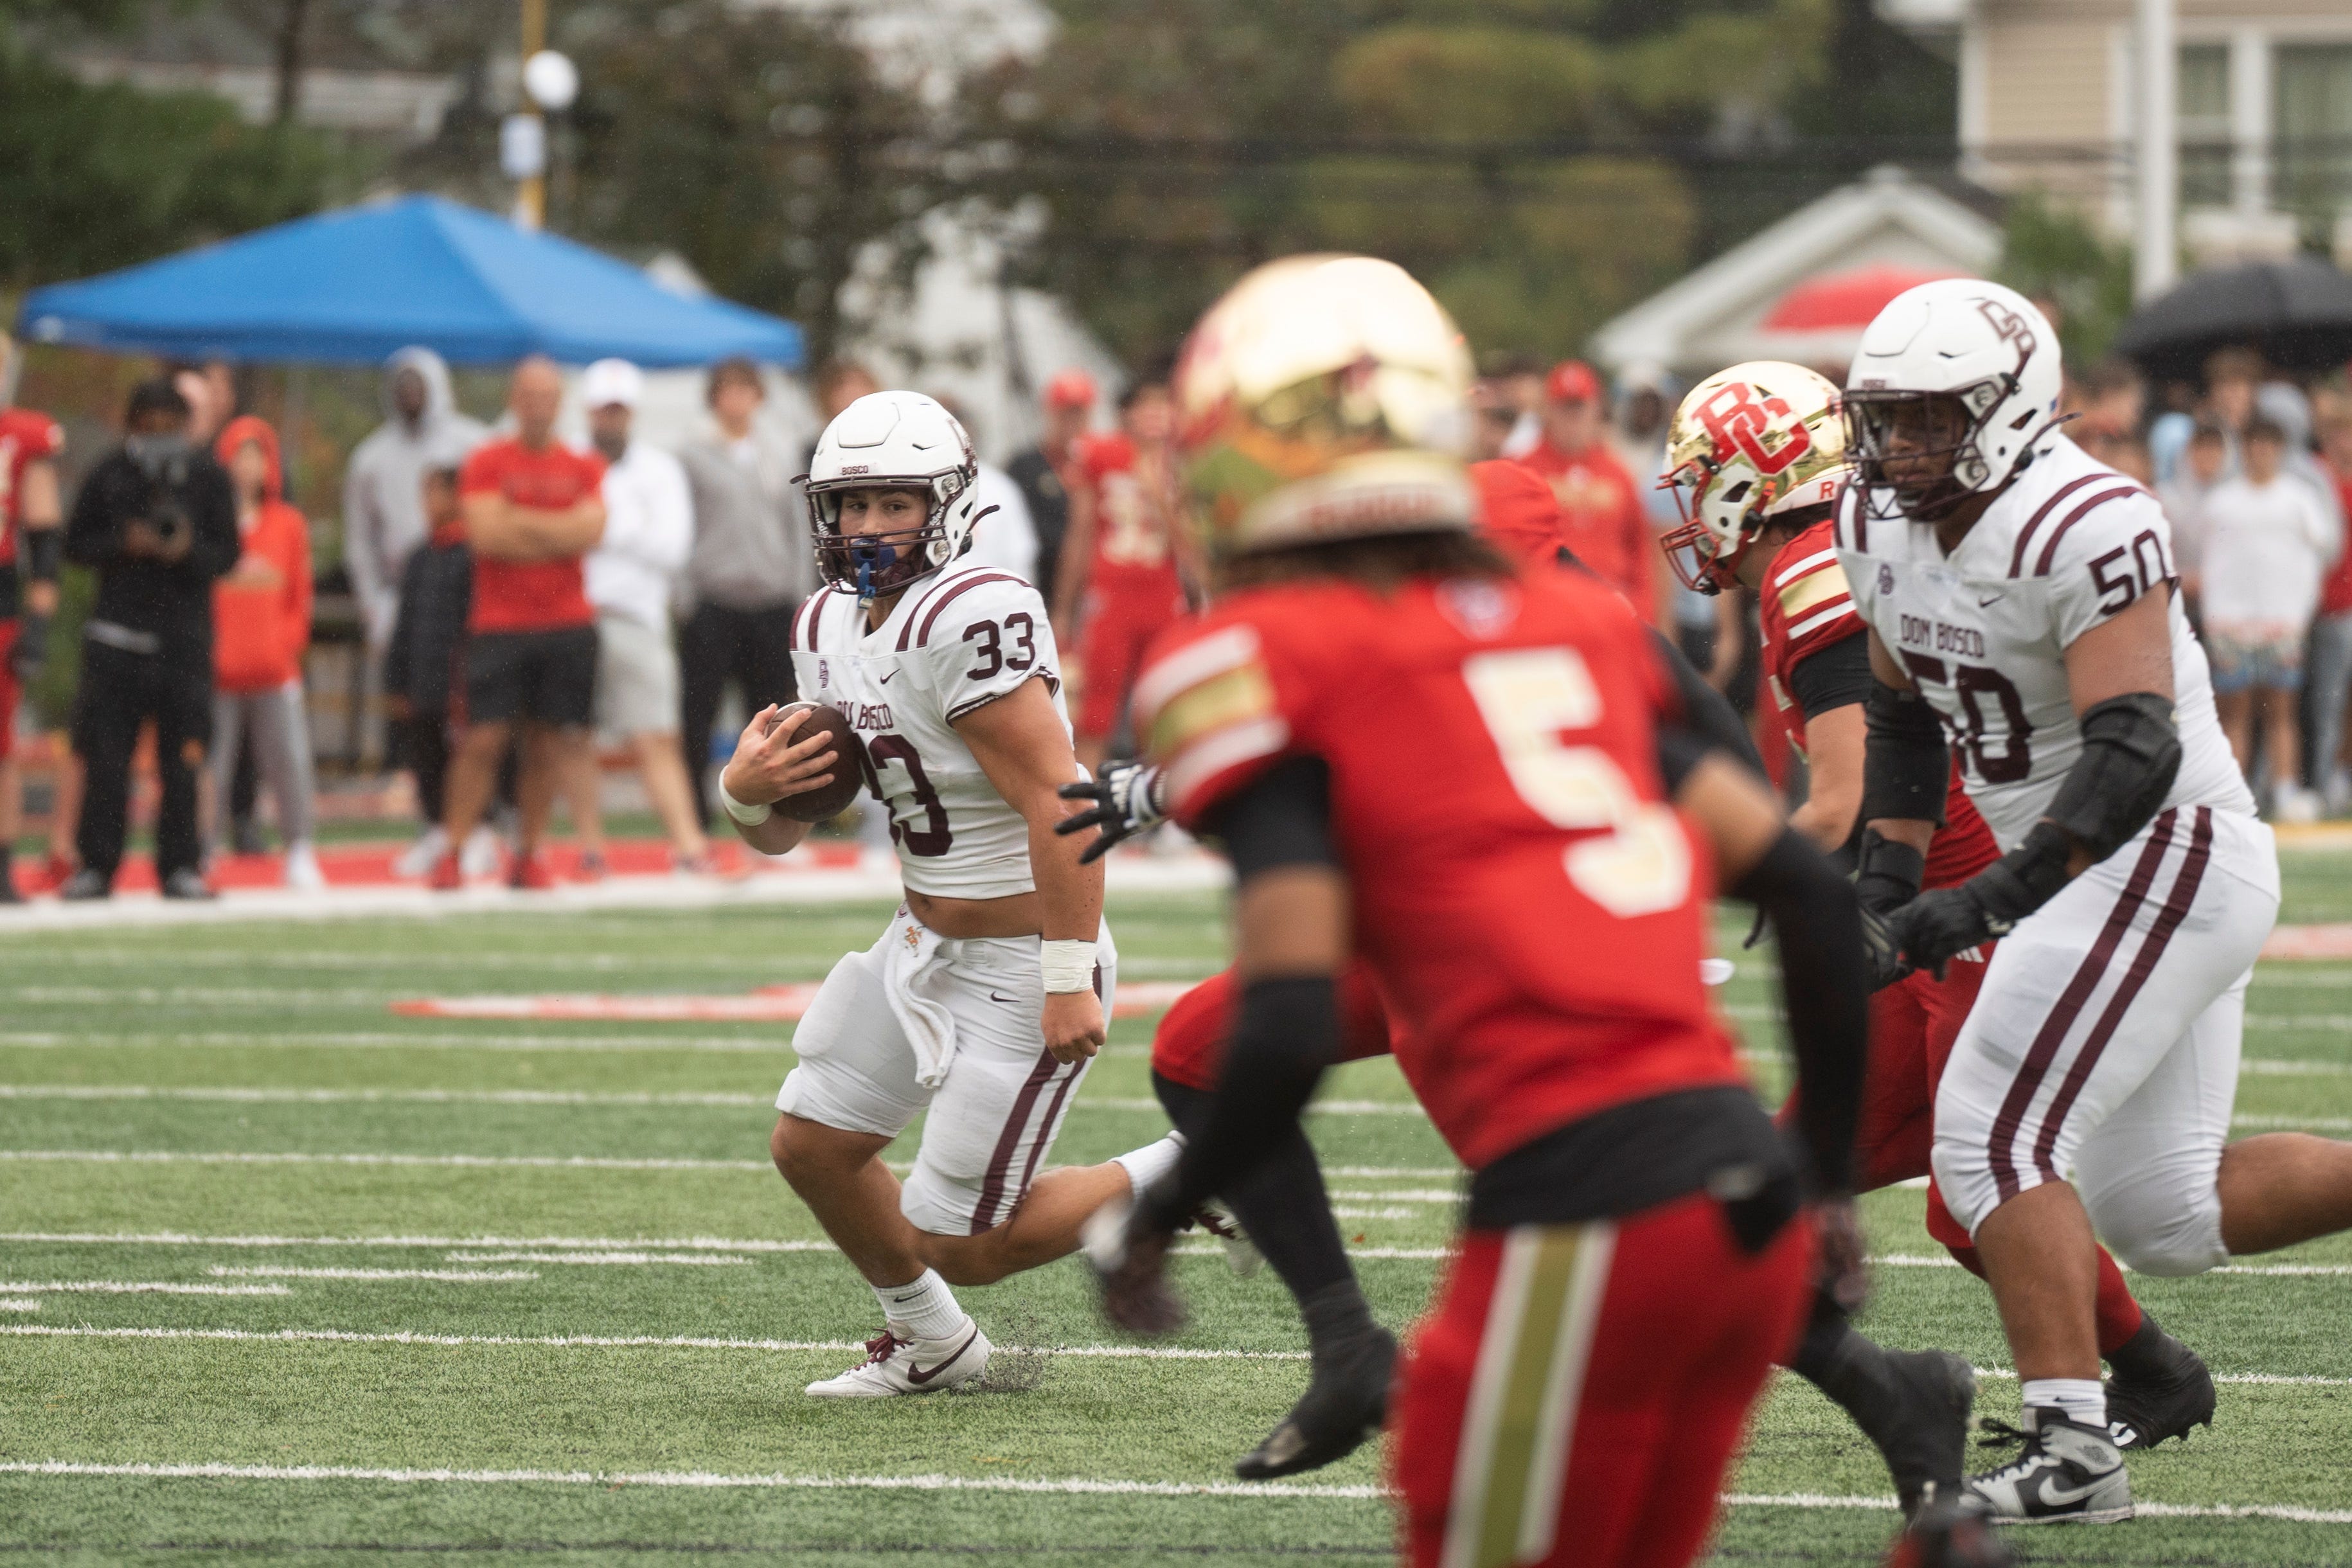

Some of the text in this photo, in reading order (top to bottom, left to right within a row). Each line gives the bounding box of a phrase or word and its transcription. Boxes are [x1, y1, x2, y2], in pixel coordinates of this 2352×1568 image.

[841, 465, 869, 476] BOSCO
[2087, 529, 2170, 616] 50
[963, 612, 1037, 681] 33
[1937, 622, 1985, 659] BOSCO
[856, 703, 894, 731] BSCO
[1897, 646, 2035, 784] 50
[1460, 645, 1695, 920] 5
